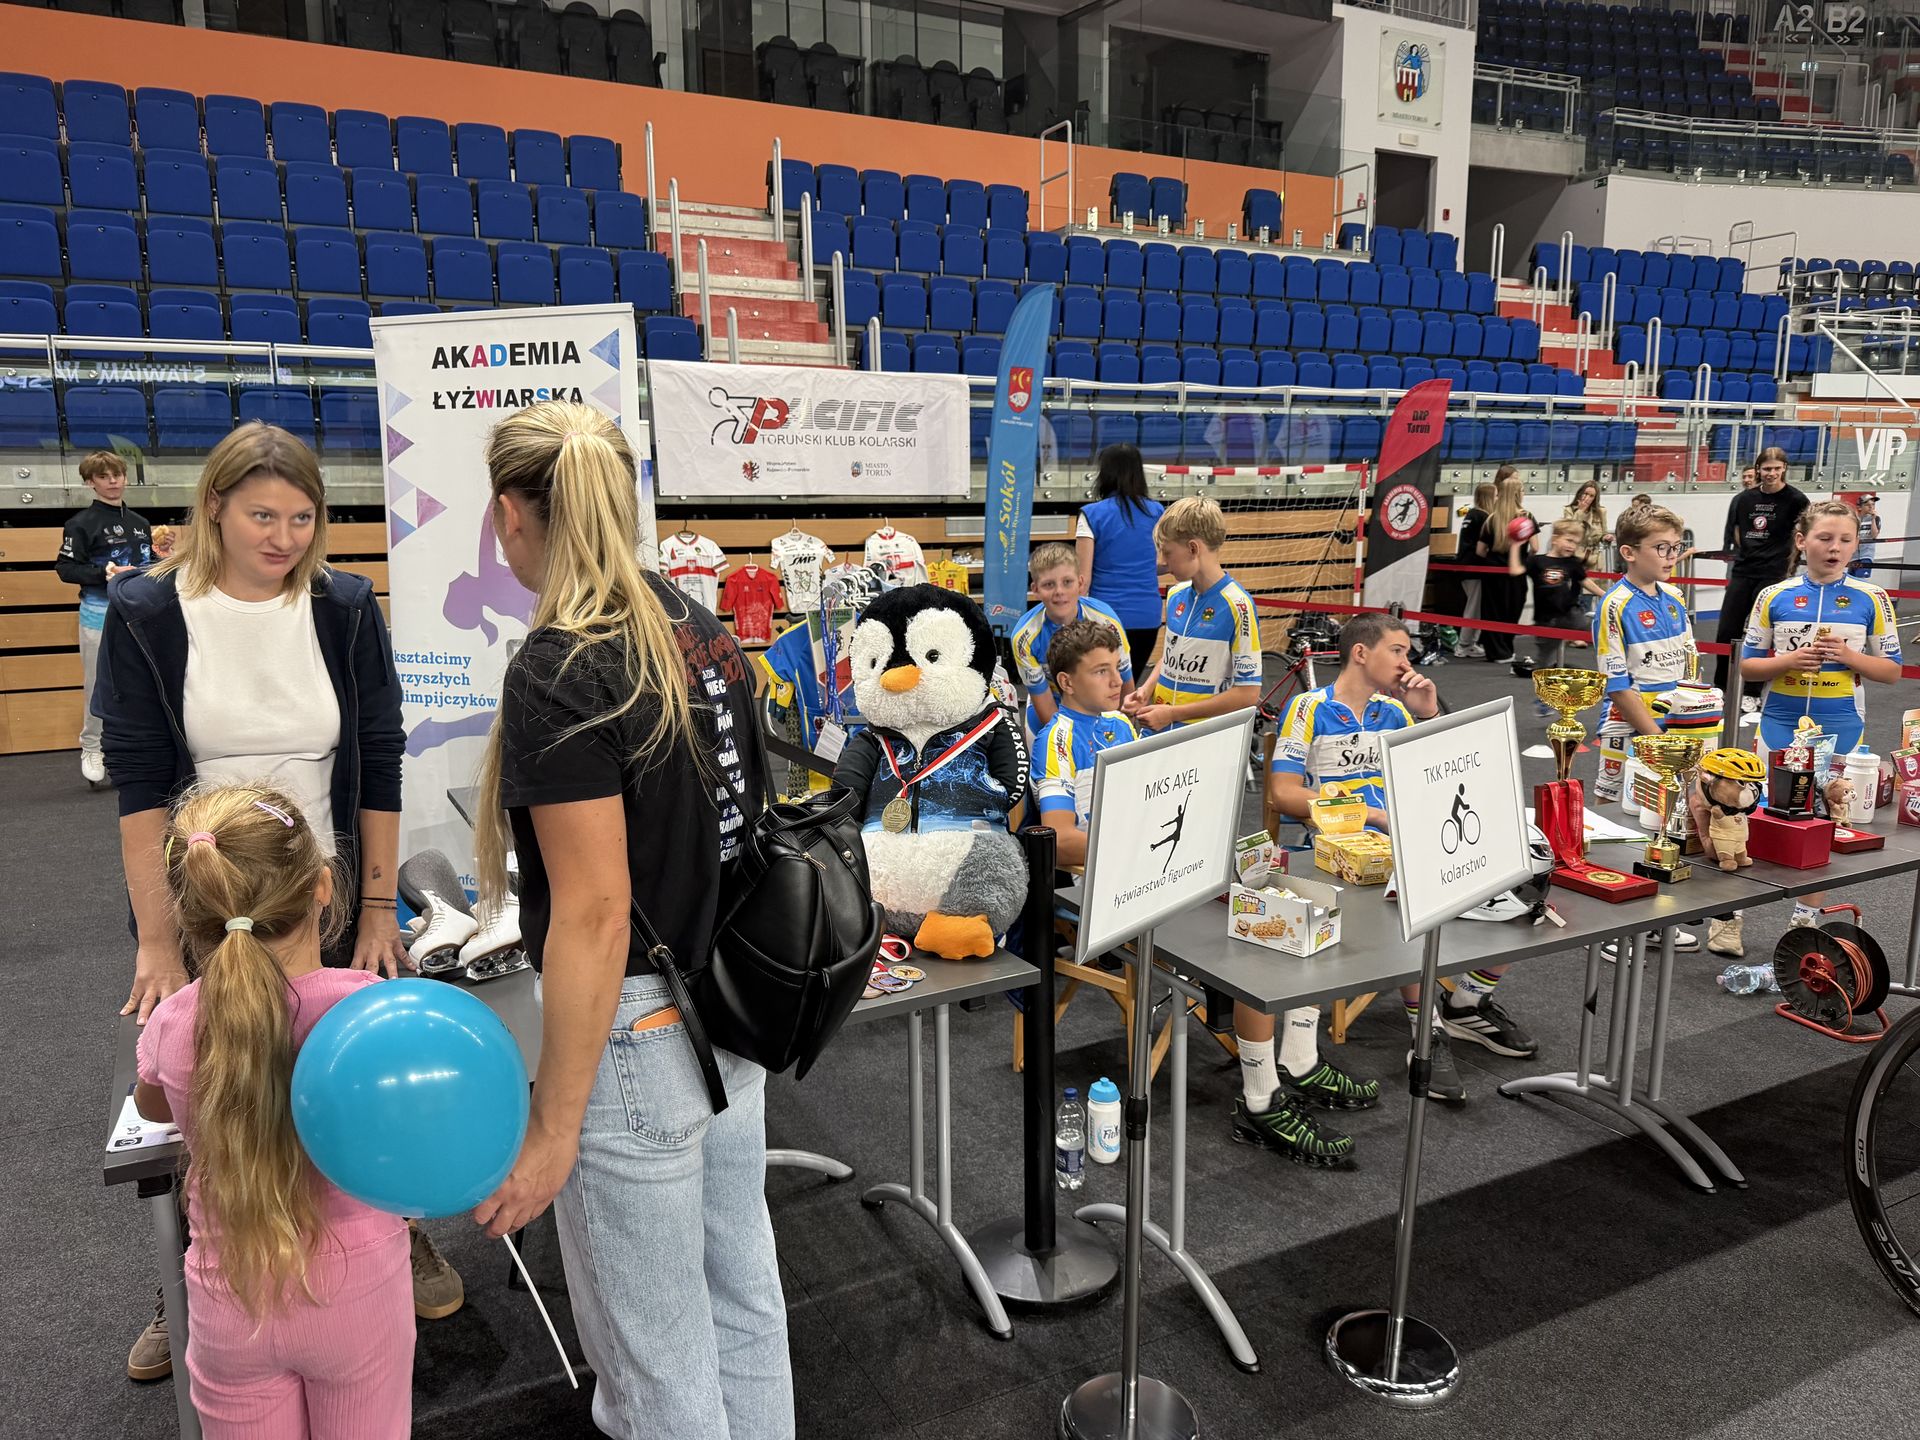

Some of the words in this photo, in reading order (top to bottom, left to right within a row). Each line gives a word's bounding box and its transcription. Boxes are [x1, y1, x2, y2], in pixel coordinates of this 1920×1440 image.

[1773, 4, 1814, 32] A2
[1827, 6, 1866, 33] B2
[431, 340, 581, 369] AKADEMIA
[432, 386, 583, 410] ŁYŻWIARSKA
[743, 397, 925, 444] PACIFIC
[825, 435, 856, 447] KLUB
[859, 436, 917, 448] KOLARSKI
[1855, 427, 1907, 471] VIP
[999, 460, 1016, 528] Sokół
[789, 556, 816, 567] SMP
[394, 650, 471, 669] kształcimy
[1163, 647, 1209, 673] Sokół
[1233, 660, 1258, 670] Fitness
[1654, 652, 1672, 662] UKS
[401, 690, 498, 708] limpijczyków
[1423, 764, 1442, 785] TKK
[1444, 751, 1482, 778] PACIFIC
[1144, 777, 1170, 802] MKS
[1172, 767, 1200, 793] AXEL
[458, 873, 476, 886] nfo
[1113, 872, 1166, 908] łyżwiarstwo
[1168, 858, 1204, 885] figurowe
[1440, 853, 1487, 886] kolarstwo
[1239, 894, 1260, 905] CINI
[1871, 1221, 1920, 1296] -ACE
